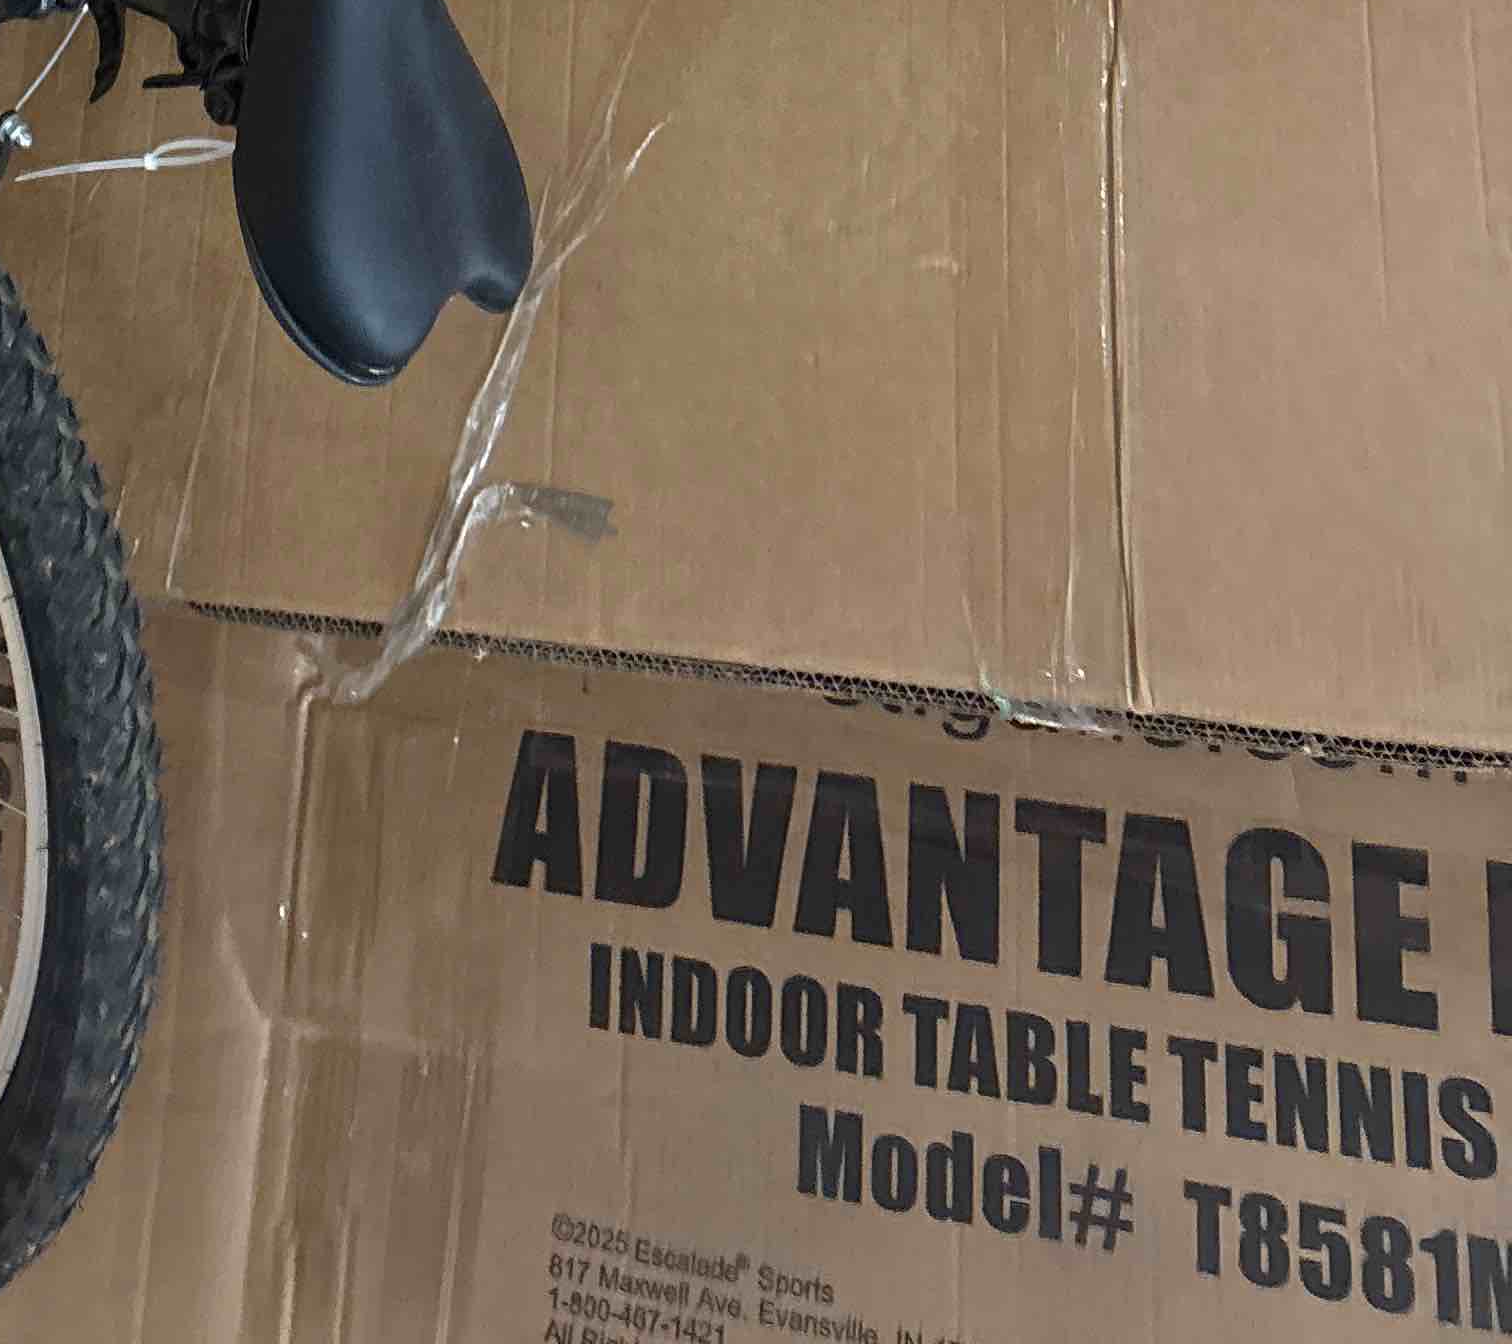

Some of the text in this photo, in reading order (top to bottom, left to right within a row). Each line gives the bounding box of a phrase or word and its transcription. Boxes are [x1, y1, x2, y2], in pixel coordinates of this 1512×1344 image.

[492, 729, 1438, 1031] ADVANTAGE
[589, 943, 1498, 1180] INDOOR TABLE TENNIS
[796, 1104, 1134, 1251] Model#
[549, 1253, 591, 1285] 817
[598, 1263, 690, 1306] Maxwell
[758, 1264, 835, 1306] Sports
